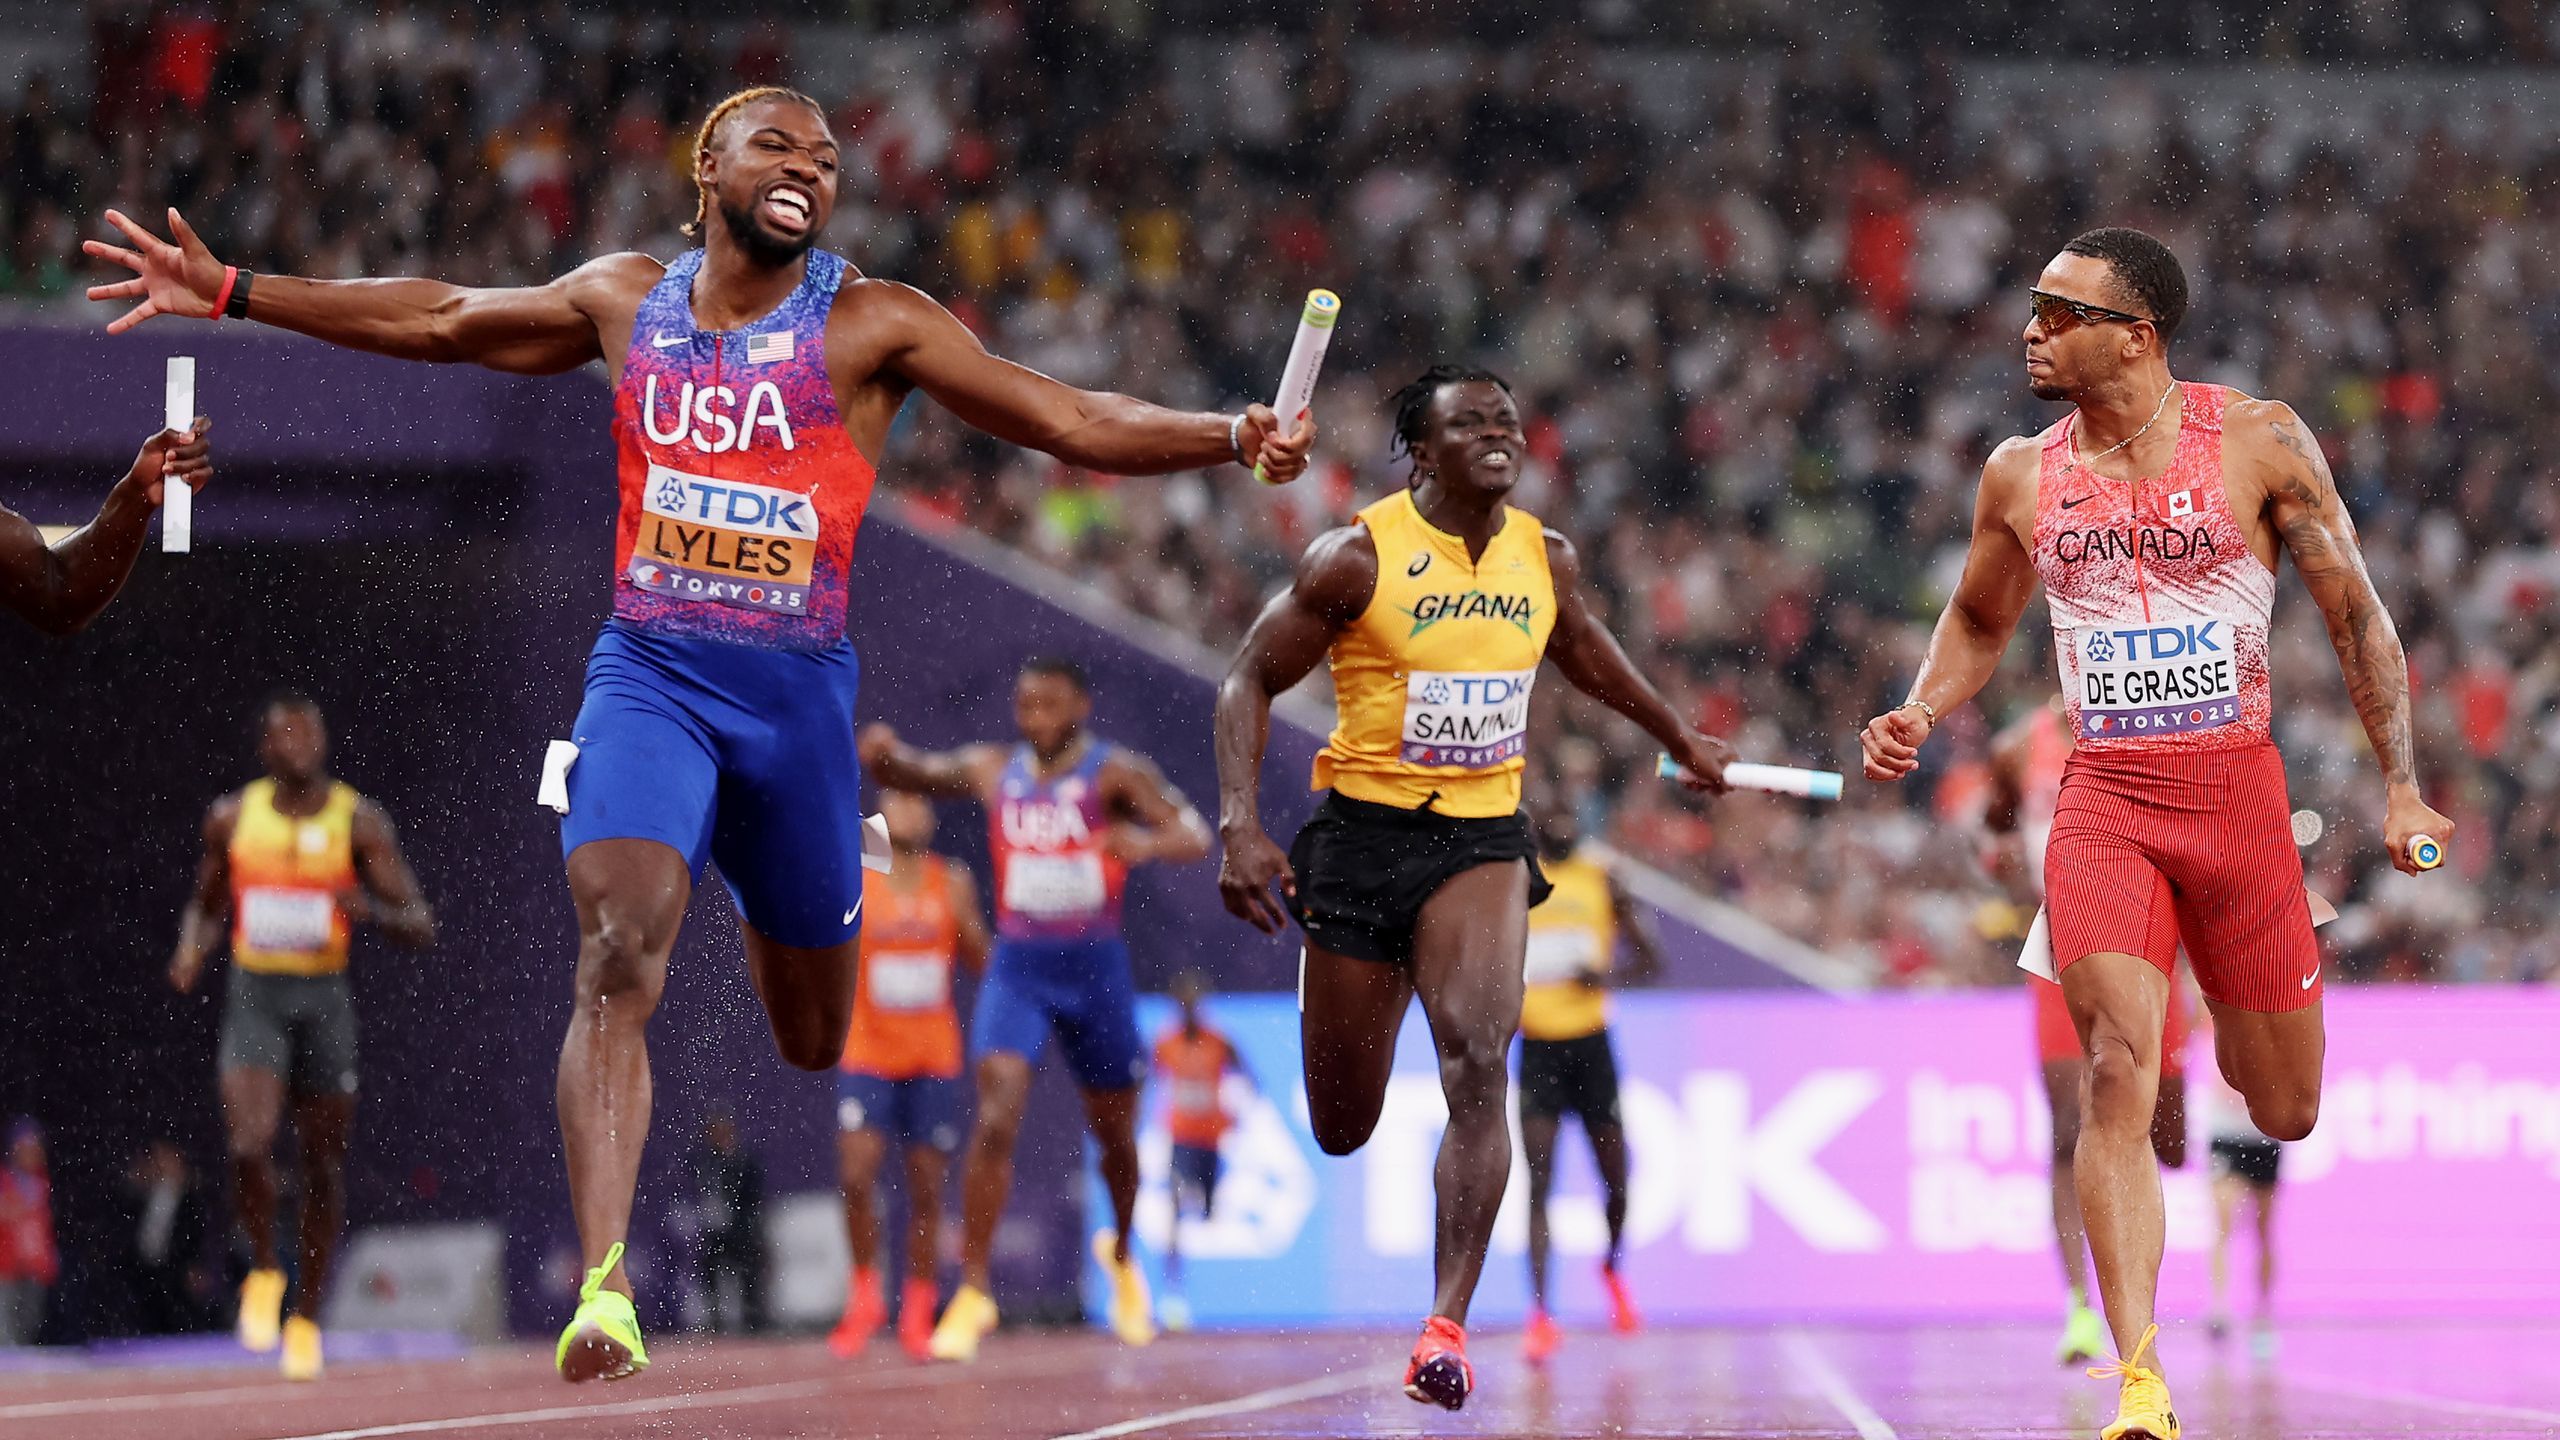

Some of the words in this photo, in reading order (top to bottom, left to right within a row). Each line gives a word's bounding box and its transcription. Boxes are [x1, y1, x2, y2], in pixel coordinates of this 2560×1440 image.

[643, 374, 795, 453] USA
[689, 482, 806, 533] TDK
[653, 521, 792, 577] LYLES
[2056, 527, 2216, 563] CANADA
[1413, 593, 1531, 621] GHANA
[2113, 620, 2222, 661] TDK
[1452, 673, 1531, 705] TDK
[2087, 672, 2117, 704] DE
[2124, 660, 2230, 703] GRASSE
